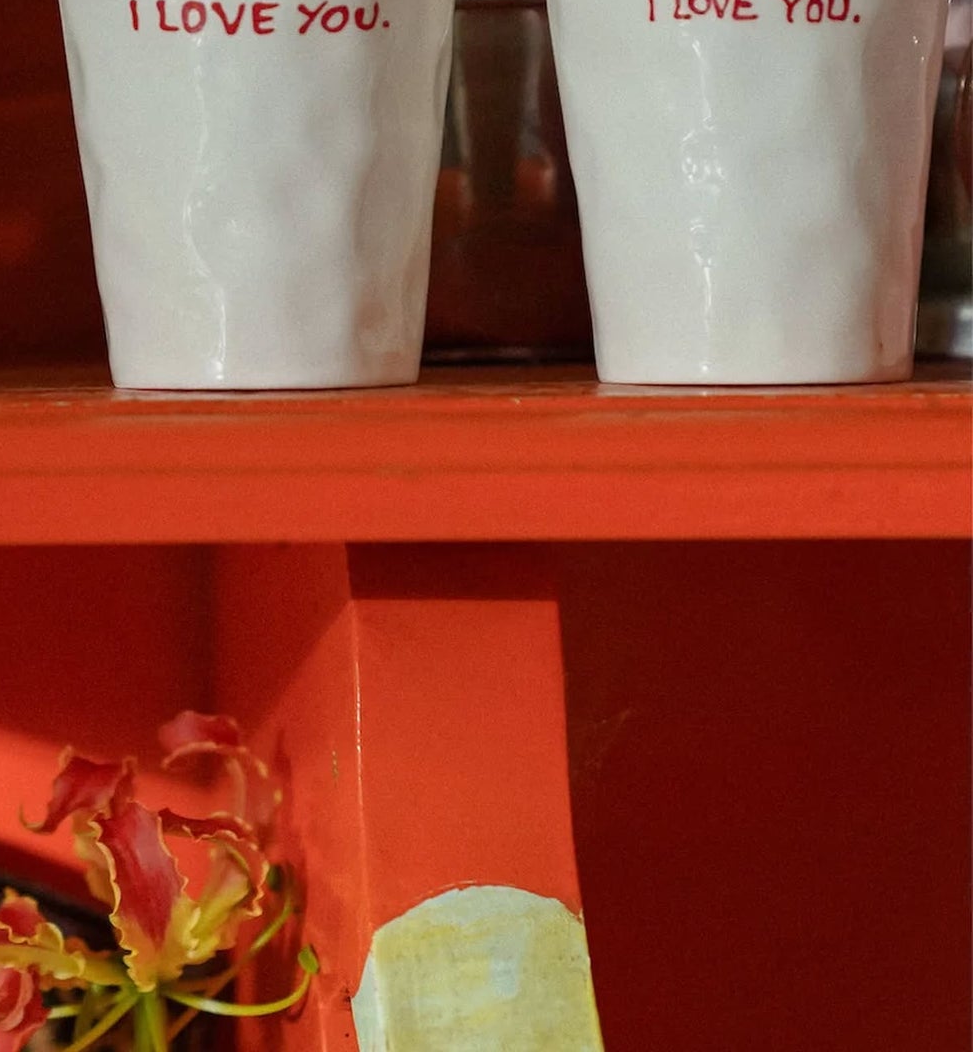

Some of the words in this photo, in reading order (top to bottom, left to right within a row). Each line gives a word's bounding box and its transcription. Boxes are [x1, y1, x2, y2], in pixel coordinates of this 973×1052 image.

[129, 0, 139, 32] I
[156, 0, 279, 36] LOVE
[297, 0, 391, 35] YOU.
